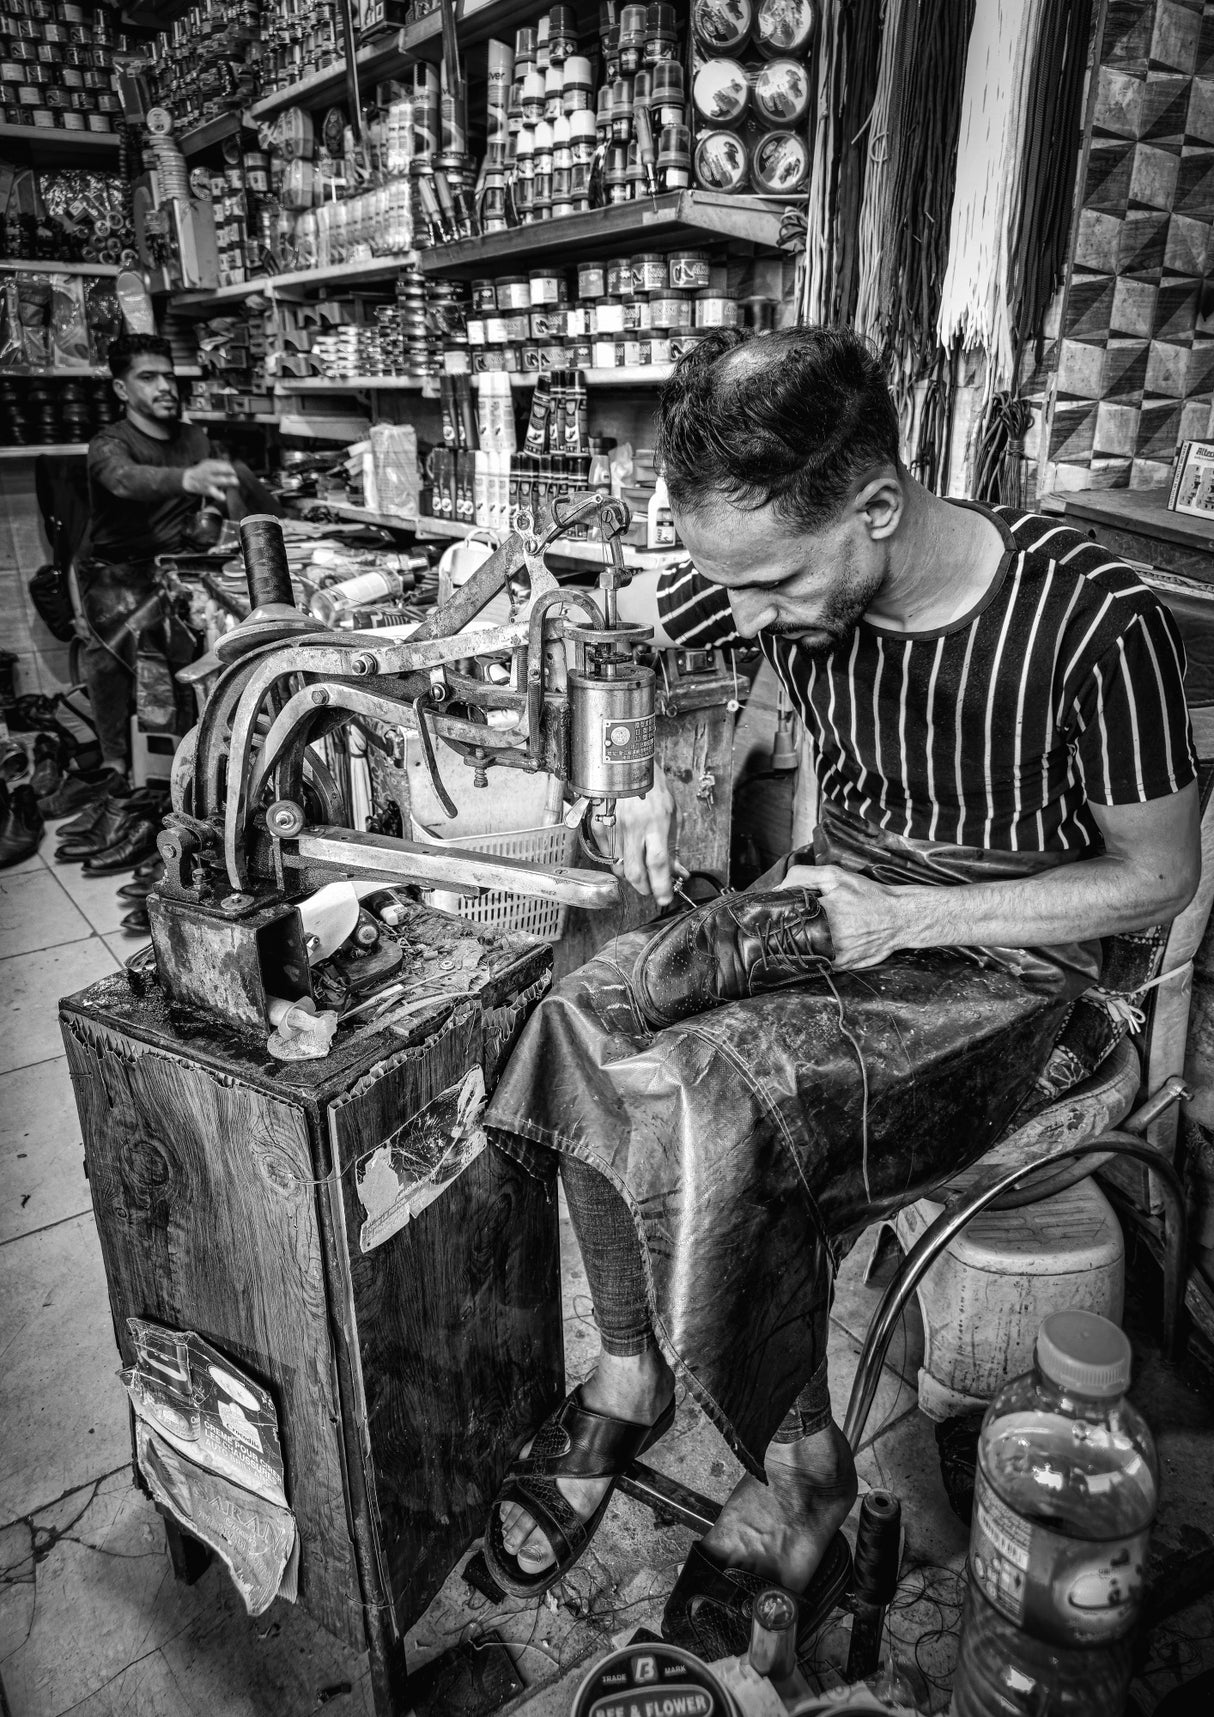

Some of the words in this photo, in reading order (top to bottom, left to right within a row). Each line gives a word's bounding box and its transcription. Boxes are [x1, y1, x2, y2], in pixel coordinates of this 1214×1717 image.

[204, 1428, 221, 1444] LES
[222, 1441, 278, 1486] CHAUSSURES
[205, 1438, 229, 1457] AUTO
[233, 1441, 259, 1463] POUR
[602, 1673, 627, 1683] TRADE
[664, 1665, 687, 1675] MARK
[645, 1694, 707, 1717] FLOWER
